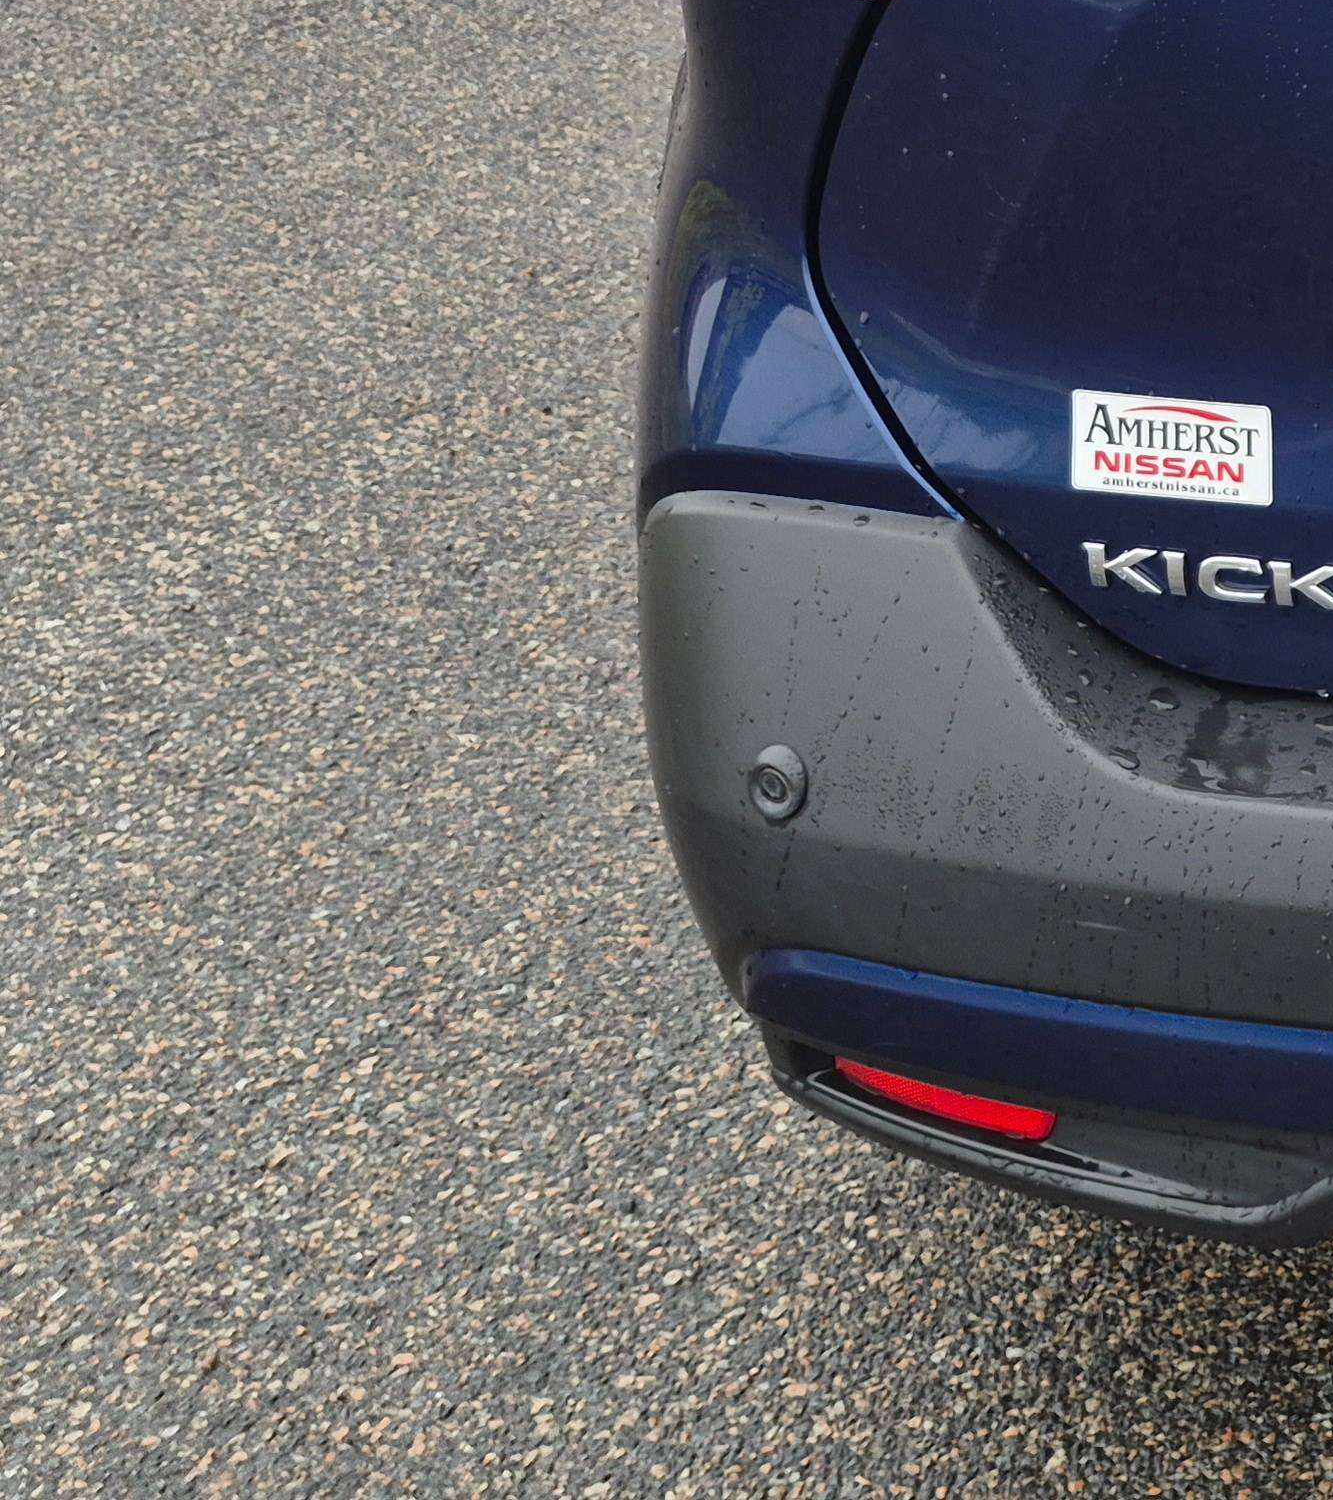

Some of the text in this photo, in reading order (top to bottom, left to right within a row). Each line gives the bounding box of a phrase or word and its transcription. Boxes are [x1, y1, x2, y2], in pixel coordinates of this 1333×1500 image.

[1084, 403, 1260, 458] AMHERST
[1094, 450, 1245, 483] NISSAN
[1102, 475, 1240, 497] amherstnissan.ca
